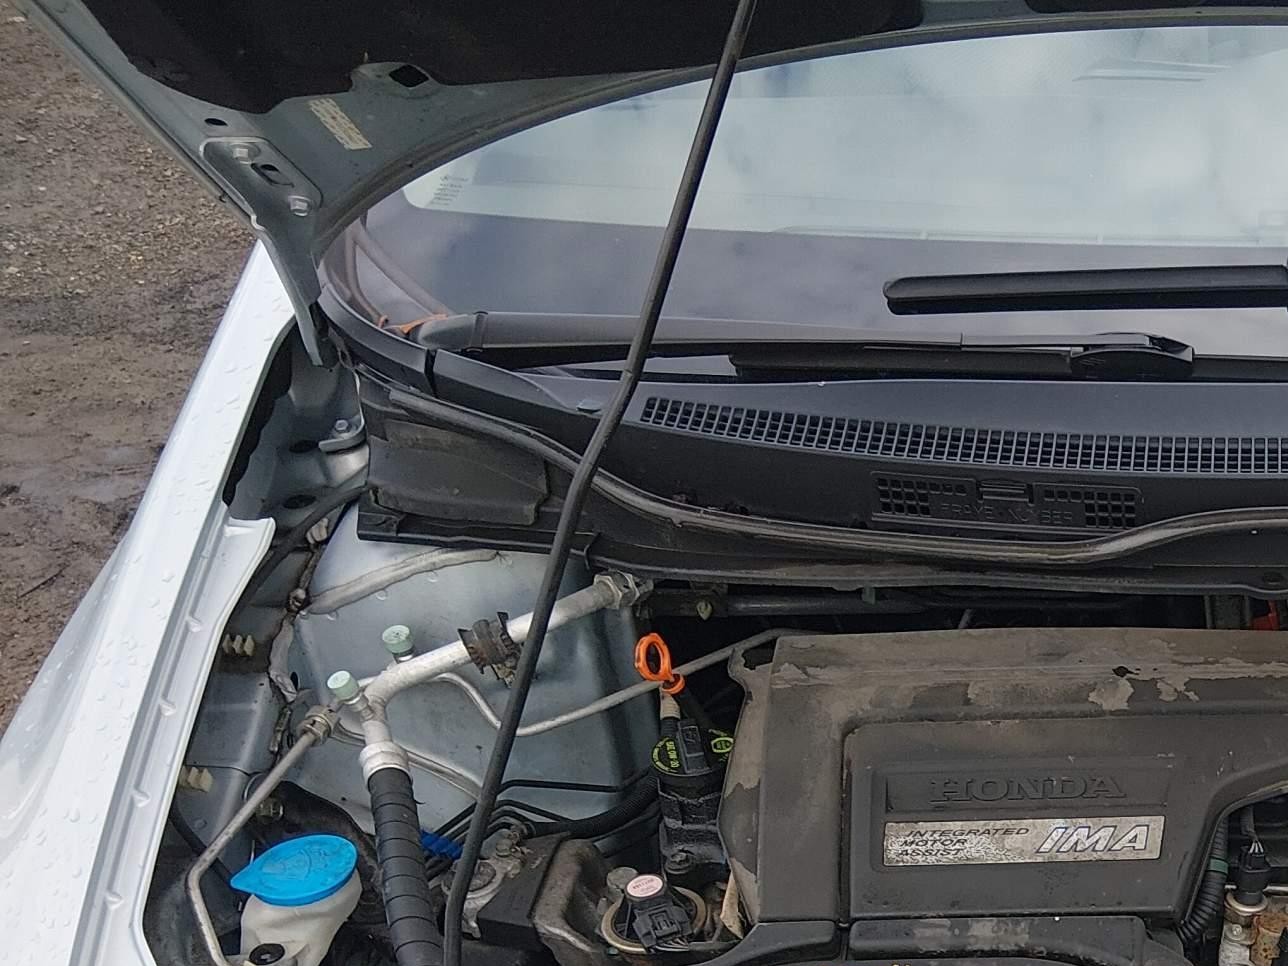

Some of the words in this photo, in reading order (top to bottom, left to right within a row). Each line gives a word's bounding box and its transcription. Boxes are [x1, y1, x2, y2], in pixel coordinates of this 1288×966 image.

[1007, 506, 1074, 525] NUBER
[929, 776, 1126, 804] HONDA
[906, 827, 1030, 838] INTEGRATED
[1035, 824, 1150, 854] IMA
[899, 838, 968, 847] MOTOR
[898, 848, 962, 858] ASSIST
